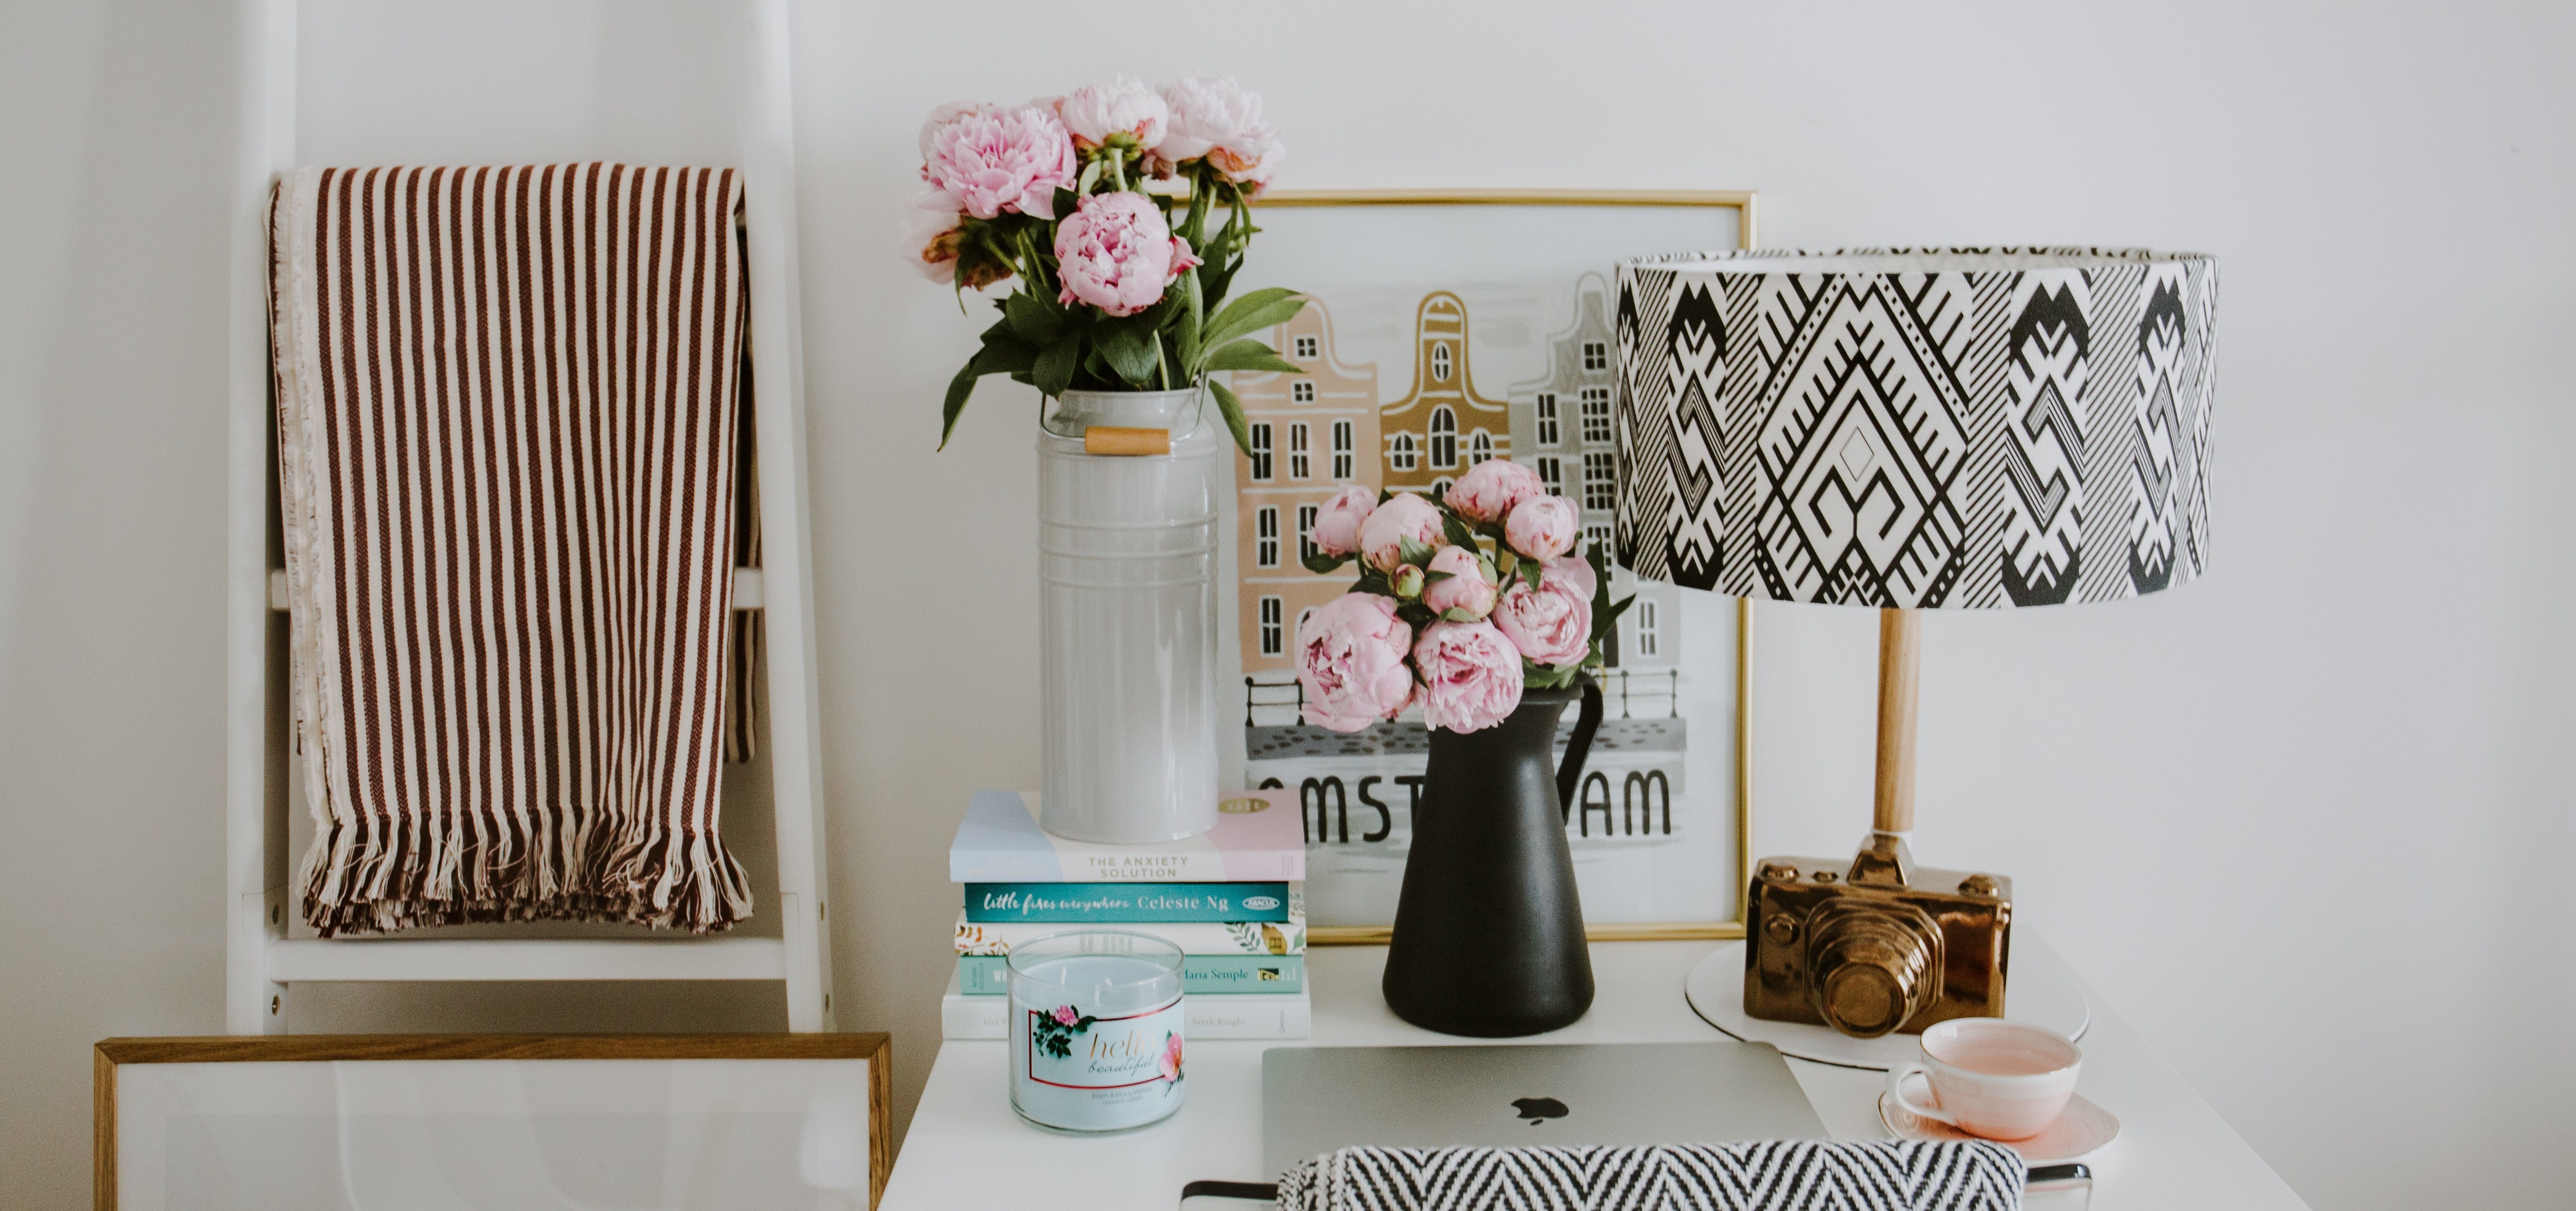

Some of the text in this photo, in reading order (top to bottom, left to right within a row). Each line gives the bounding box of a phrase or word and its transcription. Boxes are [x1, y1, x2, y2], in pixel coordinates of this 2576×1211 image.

[1260, 769, 1671, 843] MSTAM
[1089, 857, 1188, 867] THE ANXIETY
[1101, 868, 1176, 877] SOLUTION
[1022, 893, 1056, 916] fires
[1060, 896, 1129, 913] everywhere
[1138, 895, 1229, 912] Celeste Ng
[1211, 968, 1248, 981] Semple
[1193, 1017, 1246, 1027] Sarah Knight
[1089, 1027, 1155, 1059] hello
[1088, 1052, 1156, 1077] beautiful
